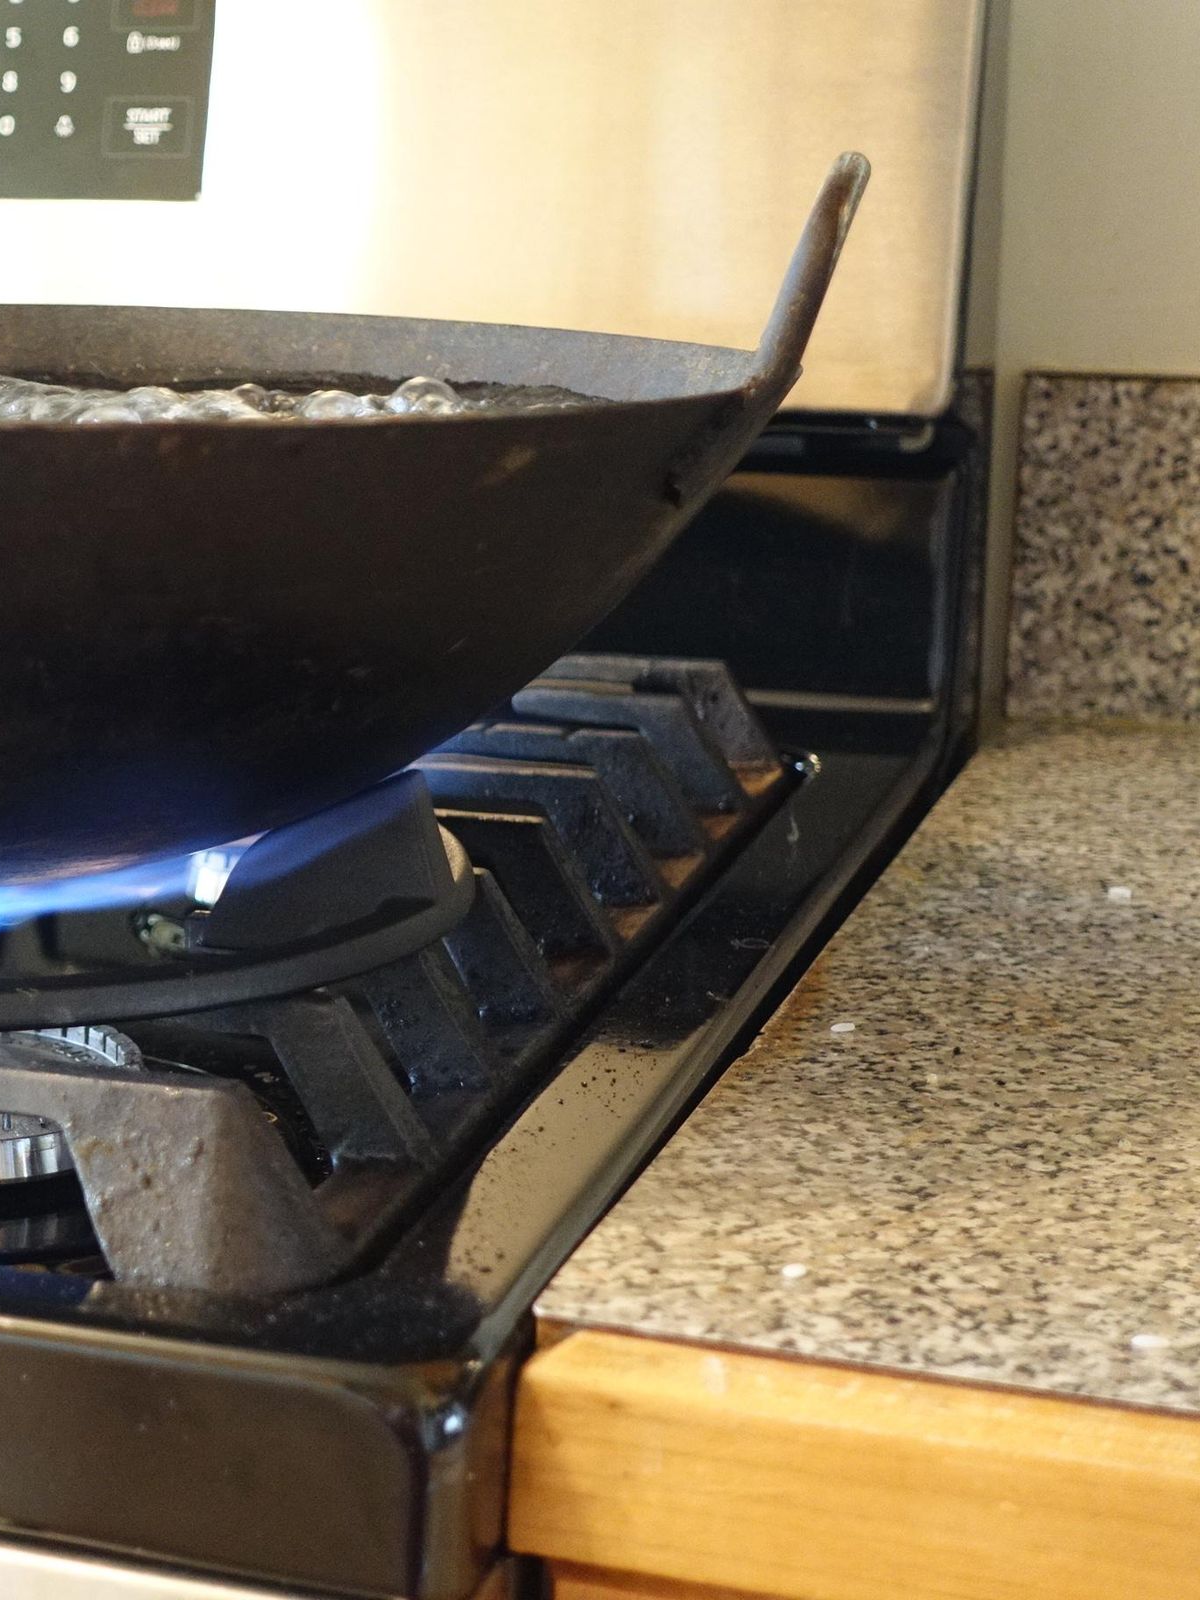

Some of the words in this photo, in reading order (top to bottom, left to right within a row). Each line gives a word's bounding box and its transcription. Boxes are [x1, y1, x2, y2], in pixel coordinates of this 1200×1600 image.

[5, 26, 22, 48] 5
[63, 26, 80, 48] 6
[2, 70, 18, 93] 8
[60, 70, 77, 93] 9
